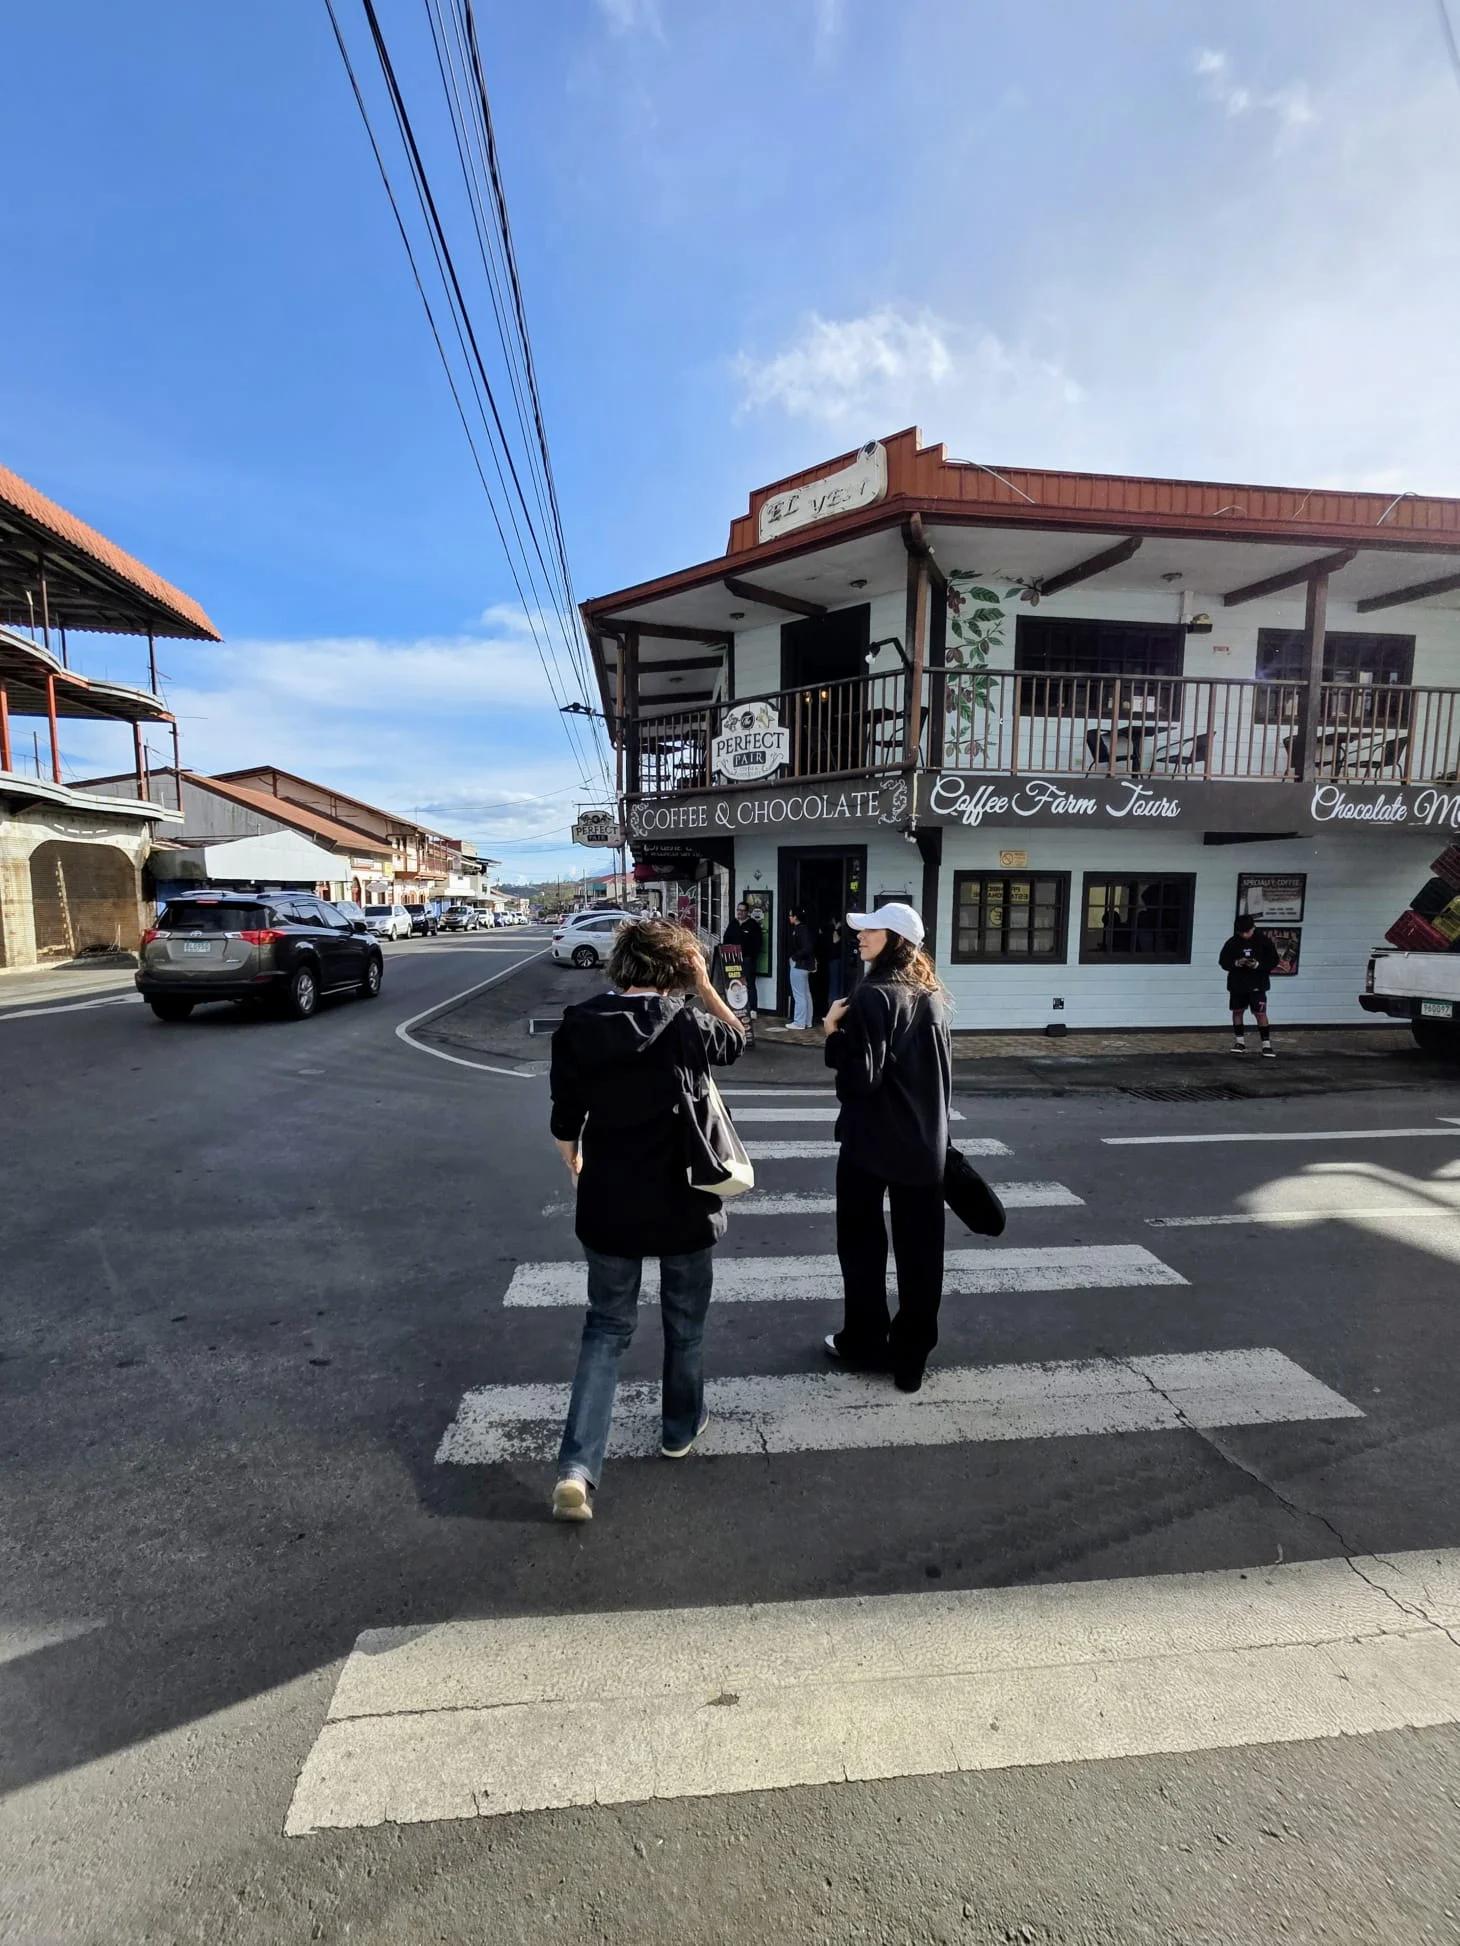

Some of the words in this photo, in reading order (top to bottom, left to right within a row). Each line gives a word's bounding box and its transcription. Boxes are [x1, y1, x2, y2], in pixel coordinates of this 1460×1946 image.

[716, 732, 785, 758] PERFECT
[735, 751, 764, 766] PAIR
[642, 805, 708, 830] COFFEE
[715, 800, 736, 829] &
[737, 790, 880, 825] CHOCOLATE
[930, 776, 1009, 827] Coffee
[1011, 780, 1097, 817] Farm
[1105, 781, 1182, 818] Tours
[1311, 784, 1408, 821] Chocolate
[1413, 789, 1460, 828] M
[576, 825, 619, 836] PERFECT
